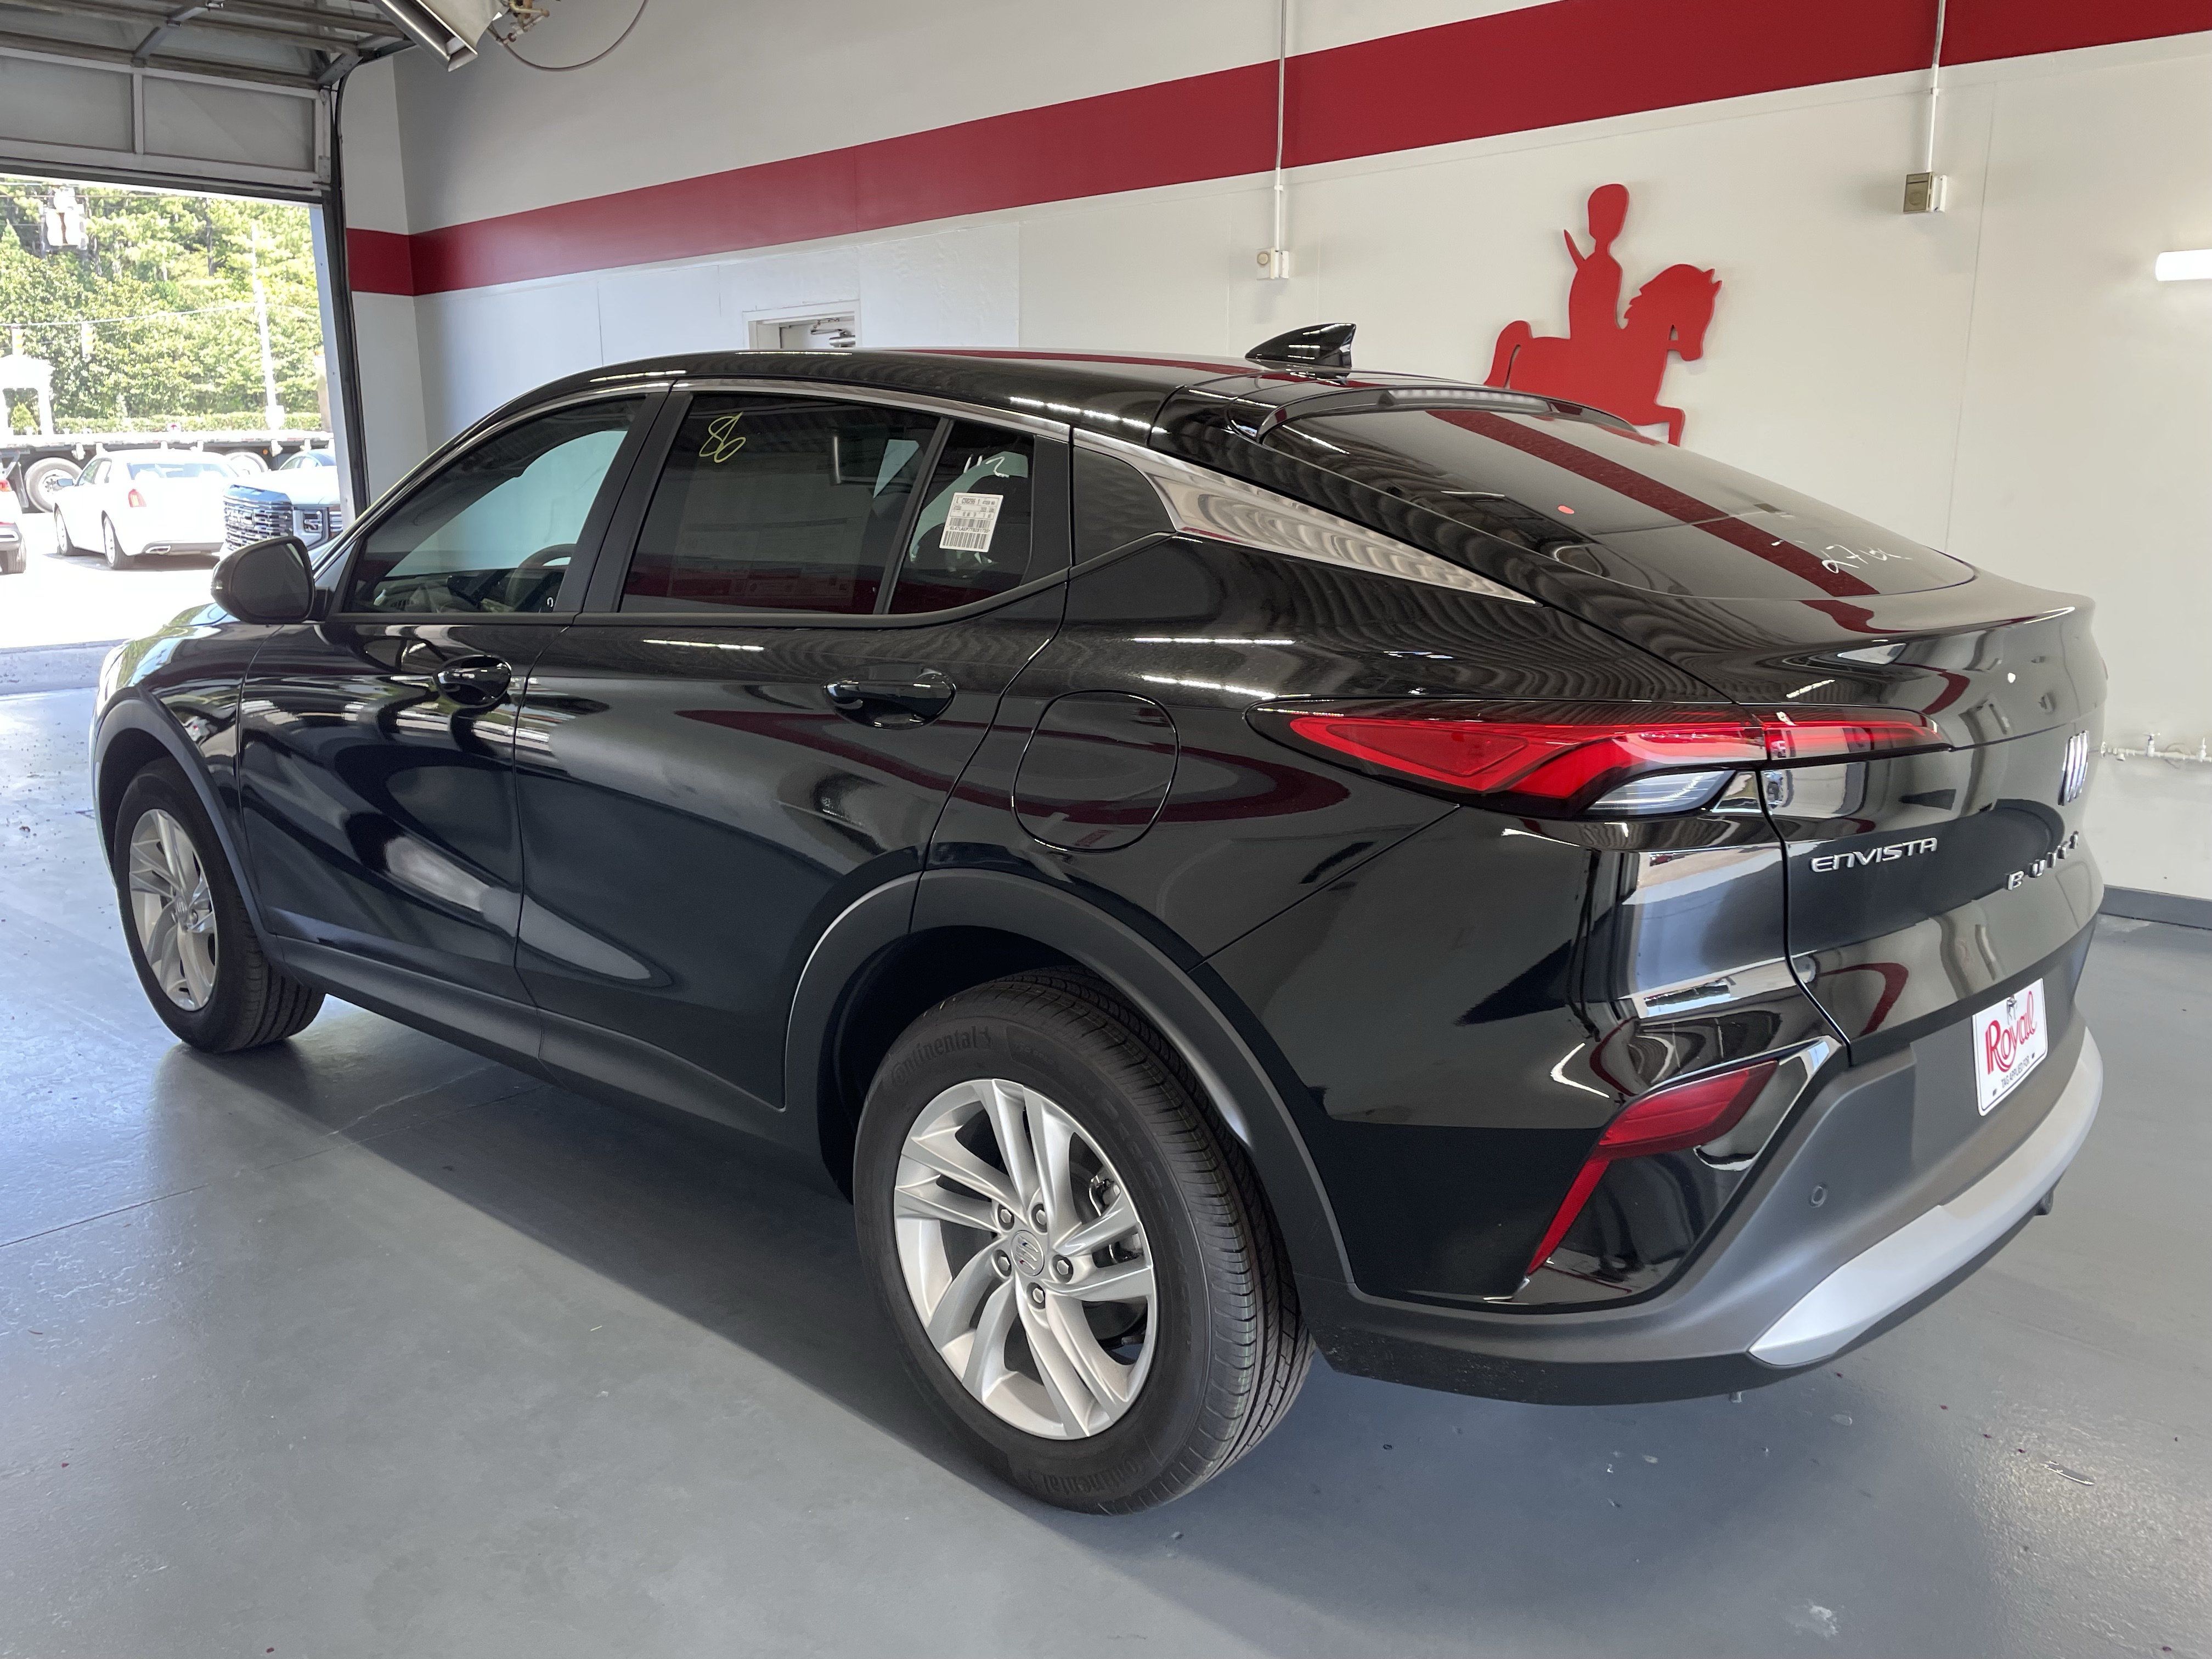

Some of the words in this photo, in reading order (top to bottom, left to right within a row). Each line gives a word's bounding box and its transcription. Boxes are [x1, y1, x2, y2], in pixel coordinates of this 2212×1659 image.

[1811, 837, 1938, 873] ENVISTA
[890, 1025, 978, 1085] Continental
[1985, 991, 2037, 1075] Royal
